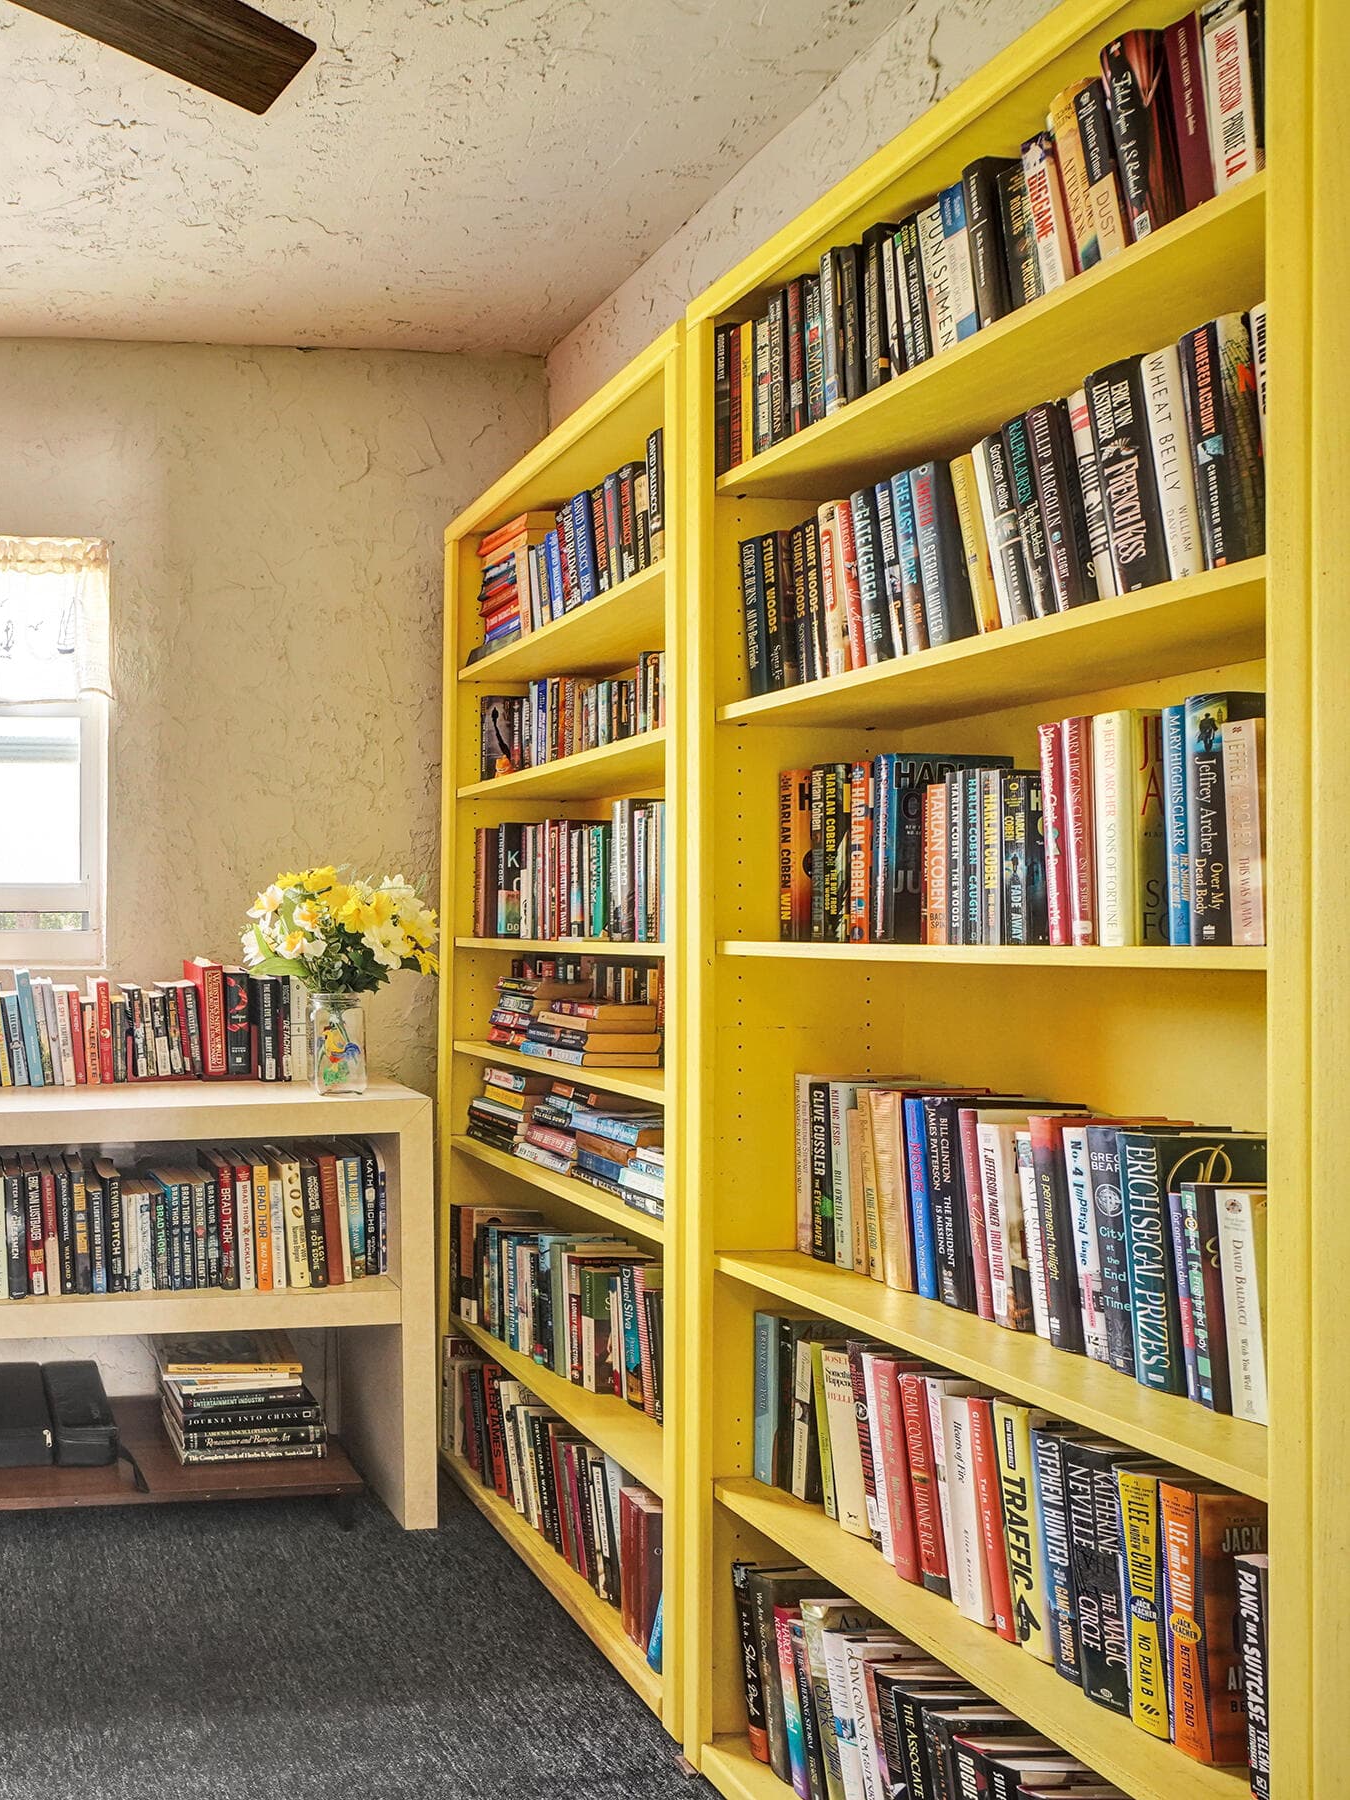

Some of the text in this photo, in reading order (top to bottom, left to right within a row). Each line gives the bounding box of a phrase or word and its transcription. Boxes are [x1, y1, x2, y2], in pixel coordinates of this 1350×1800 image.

[1214, 26, 1239, 63] JAMES
[1219, 60, 1243, 115] PATTERSON
[1084, 118, 1103, 179] Martha Grimes
[1222, 111, 1246, 155] PRIVATE
[1096, 190, 1116, 238] DUST
[908, 257, 926, 360] THE AGENT RUNNER
[927, 208, 956, 352] PUNISHMEN
[770, 347, 782, 381] GOOD
[807, 341, 825, 405] EMPIRE
[1193, 329, 1215, 437] NUMBERED ACCOUNT
[772, 382, 782, 433] GERMAN
[1091, 380, 1115, 442] LUSTBADER
[1111, 380, 1134, 428] ERIC VAN
[1147, 355, 1181, 492] WHEAT BELLY
[1008, 420, 1032, 504] RALPH LAUREN
[1031, 408, 1062, 528] PHILLIP MARGOLIN
[573, 495, 588, 571] DAVID BALDACCI
[593, 498, 608, 570] DAVID BALDACCI
[894, 477, 918, 585] THE LAST TOURIST
[1104, 456, 1148, 564] FRENCH KISS
[1207, 463, 1224, 555] CHRISTOPHER REICH
[742, 544, 757, 606] GEORGE BURNS
[762, 538, 778, 634] STUART WOODS
[921, 543, 943, 634] STEPHEN HUNTER
[1169, 714, 1185, 847] MARY HIGGINS CLARK
[1194, 757, 1217, 855] Jeffrey Archer
[780, 794, 792, 920] HARLAN COBEN WIN
[851, 786, 865, 897] HARLAN COBEN
[931, 789, 946, 909] HARLAN COBEN
[952, 826, 960, 859] COBEN
[984, 794, 998, 889] HARLAN COBEN
[1104, 728, 1117, 928] JEFFREY ARCHER SONS OF FORTUNE
[952, 868, 960, 889] THE
[952, 890, 960, 928] WOODS
[1011, 884, 1023, 940] FADE AWAY
[1193, 857, 1208, 915] Dead Body
[1208, 862, 1223, 910] Over My
[813, 1089, 826, 1176] CLIVE CUSSLER
[926, 1107, 941, 1191] JAMES PATTERSON
[939, 1117, 951, 1184] BILL CLINTON
[257, 1185, 267, 1238] BRAD THOR
[984, 1154, 997, 1197] JEFFERSON
[988, 1197, 1000, 1227] PARKER
[1041, 1183, 1054, 1241] permanent
[111, 1222, 121, 1256] PITCH
[221, 1187, 233, 1244] BRAD THOR
[936, 1204, 946, 1255] IS MISSING
[944, 1195, 955, 1268] THE PRESIDENT
[990, 1230, 1002, 1253] IRON
[992, 1254, 1005, 1281] RIVER
[1045, 1243, 1059, 1280] twilight
[1126, 1144, 1170, 1368] ERICH SEGAL PRIZES
[1231, 1238, 1248, 1326] DAVID BALDACCI
[622, 1267, 633, 1330] Daniel Silva
[187, 1412, 299, 1426] JOURNEY INTO CHINA
[904, 1379, 936, 1557] DREAM COUNTRY LUANNE RICE
[1036, 1438, 1070, 1567] STEPHEN HUNTER
[1003, 1474, 1033, 1591] TRAFFIC
[1067, 1463, 1121, 1555] KATHERINE NEVILLE
[1129, 1501, 1153, 1591] LEE CHILD
[1169, 1520, 1192, 1613] LEE CHILD
[1054, 1586, 1075, 1663] GAME SNIPERS
[1078, 1596, 1103, 1651] CIRCLE
[1101, 1592, 1127, 1668] THE MAGIC
[1138, 1633, 1154, 1696] NO PLAN B
[1181, 1644, 1196, 1727] BETTER OFF DEAD
[1238, 1569, 1270, 1773] PANIC IN A SUITCASE YELENA
[902, 1703, 924, 1799] THE ASSOCIATE
[957, 1752, 977, 1800] ROGUE
